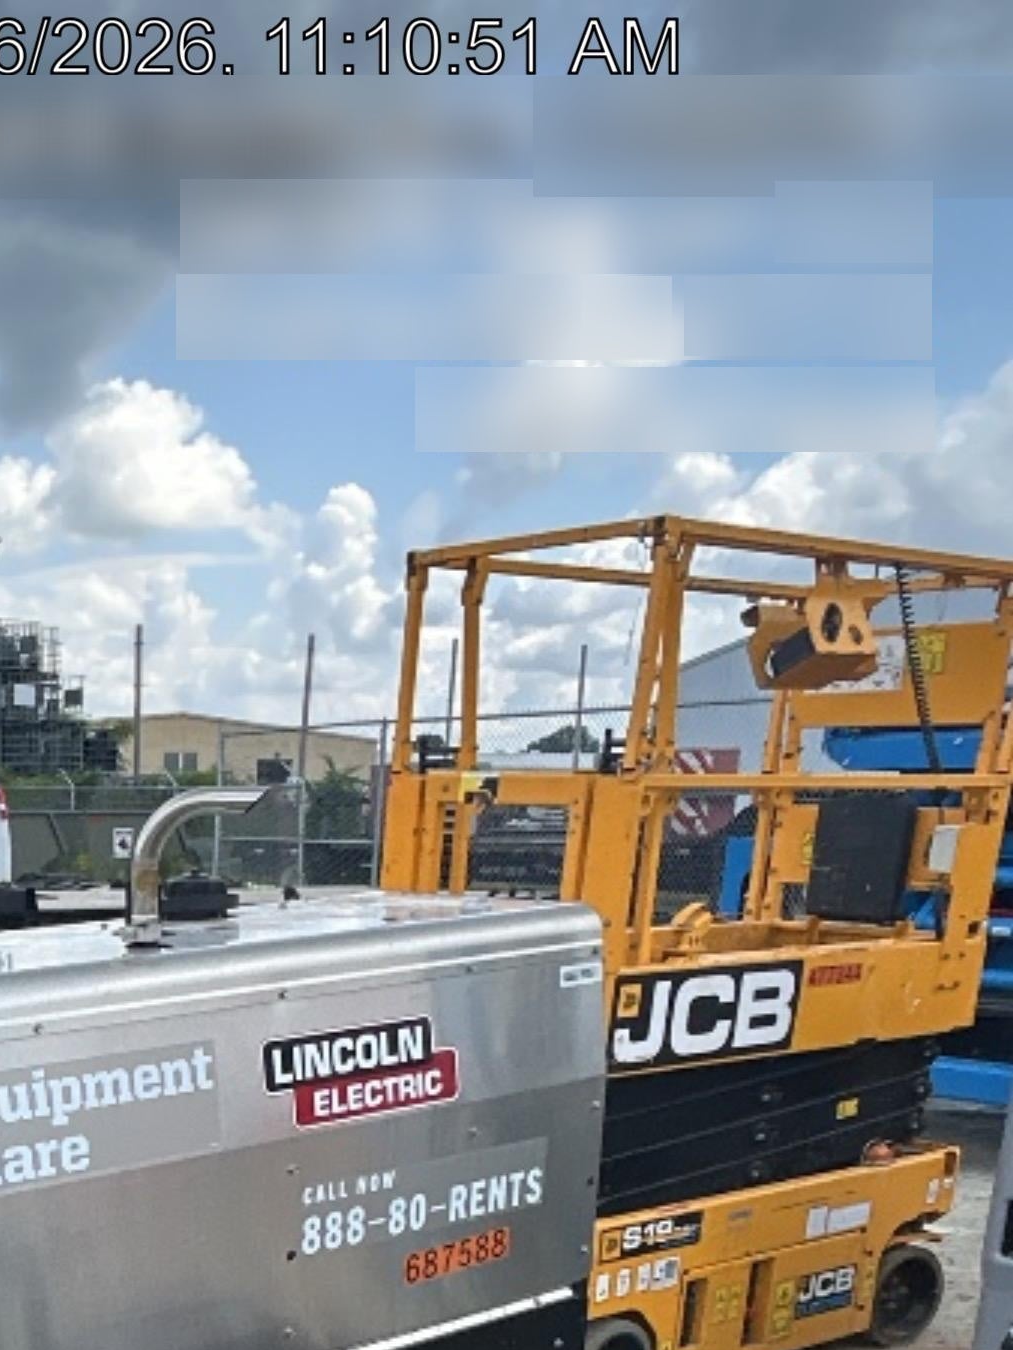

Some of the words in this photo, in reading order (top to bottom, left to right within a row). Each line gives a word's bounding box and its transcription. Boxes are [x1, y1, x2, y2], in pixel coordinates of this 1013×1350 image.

[613, 968, 796, 1064] JCB
[272, 1025, 425, 1085] LINCOLN
[313, 1068, 444, 1117] ELECTRIC
[301, 1165, 544, 1255] 888-80-RENTS
[302, 1181, 349, 1205] CALL
[356, 1169, 397, 1195] NOW
[405, 1228, 508, 1284] 687588
[798, 1266, 856, 1302] JCB
